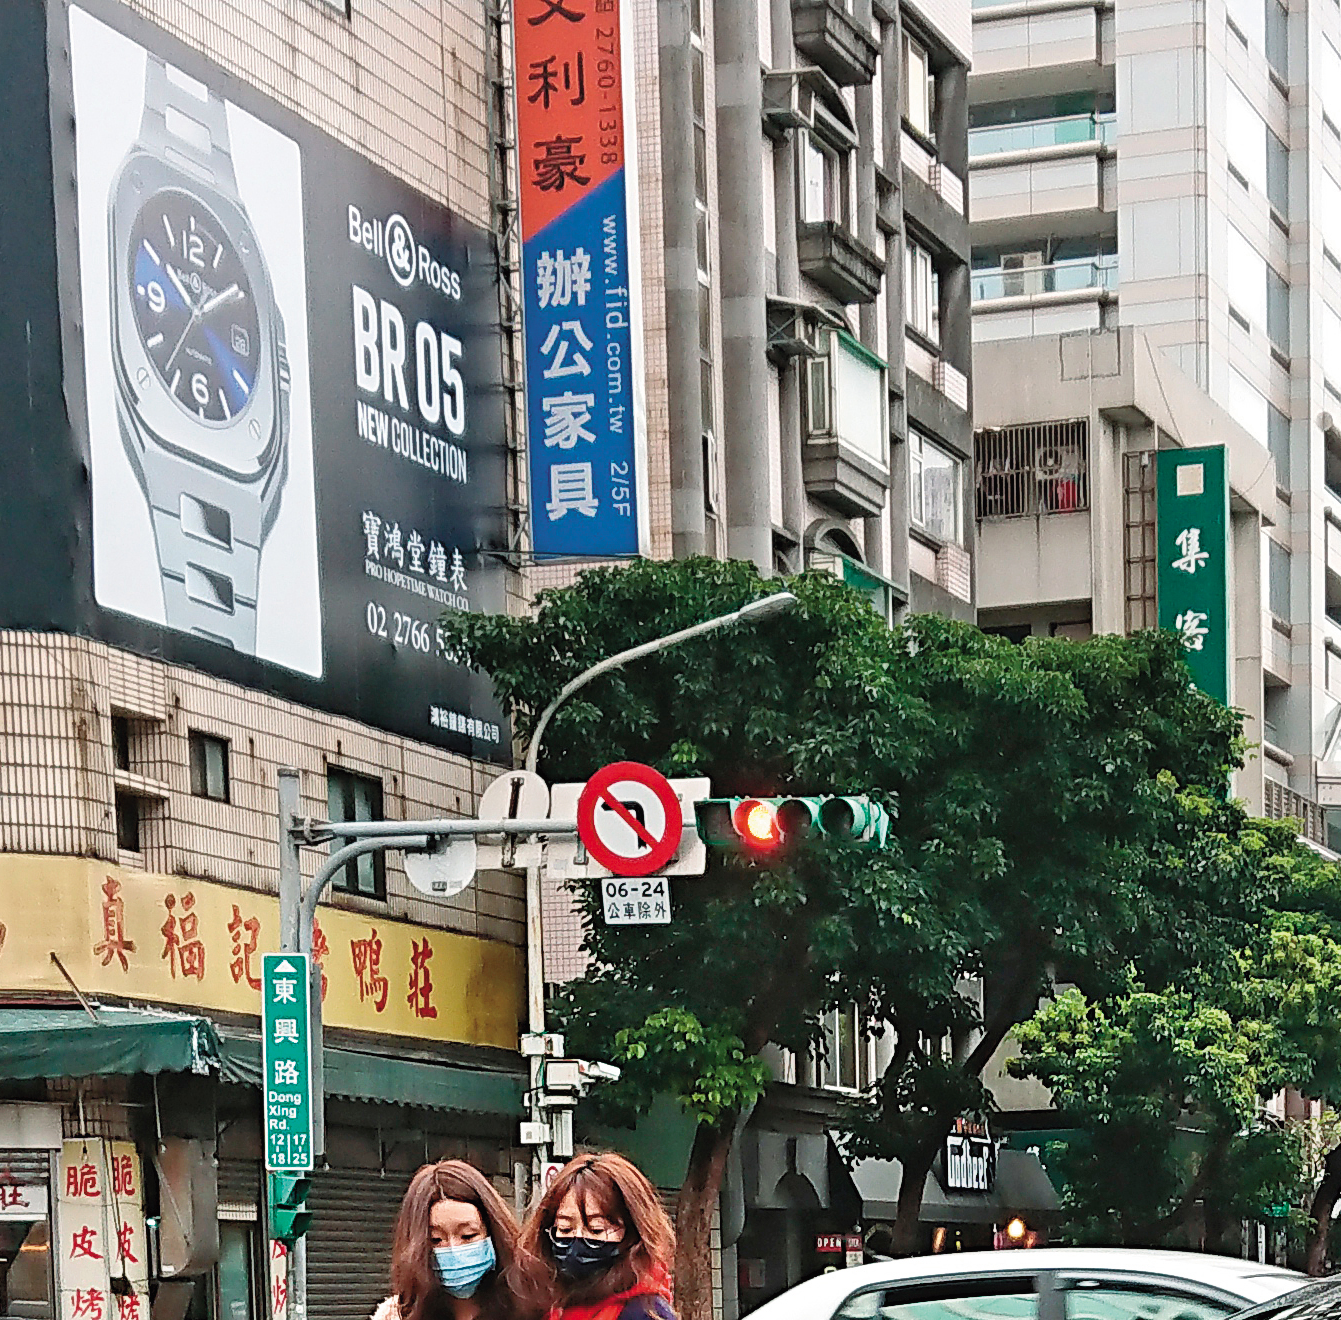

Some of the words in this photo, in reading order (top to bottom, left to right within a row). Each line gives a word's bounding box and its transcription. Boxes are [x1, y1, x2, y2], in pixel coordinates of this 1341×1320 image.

[596, 27, 618, 165] 2760-1338
[348, 204, 383, 257] Bell
[417, 244, 461, 301] Ross
[601, 214, 628, 434] www.fid.com.tw
[353, 283, 410, 412] BR
[416, 321, 465, 435] 05
[536, 247, 598, 522] 辦公家具
[357, 399, 389, 449] NEW
[391, 416, 468, 485] COLLECTION
[610, 461, 630, 519] 2/5F
[362, 510, 468, 592] 寶鴻堂鐘表
[365, 558, 383, 580] PRO
[383, 565, 427, 598] HOPETIME
[426, 582, 457, 608] WATCH
[366, 601, 388, 638] 02
[393, 611, 430, 653] 2766
[605, 881, 665, 898] 06-24
[607, 900, 667, 920] 公車除外
[272, 977, 300, 1085] 東興路
[269, 1091, 302, 1105] Dong
[269, 1105, 297, 1119] Xing
[269, 1118, 290, 1131] Rd.
[270, 1134, 285, 1145] 12
[292, 1134, 307, 1145] 17
[271, 1153, 286, 1165] 18
[292, 1153, 308, 1165] 25
